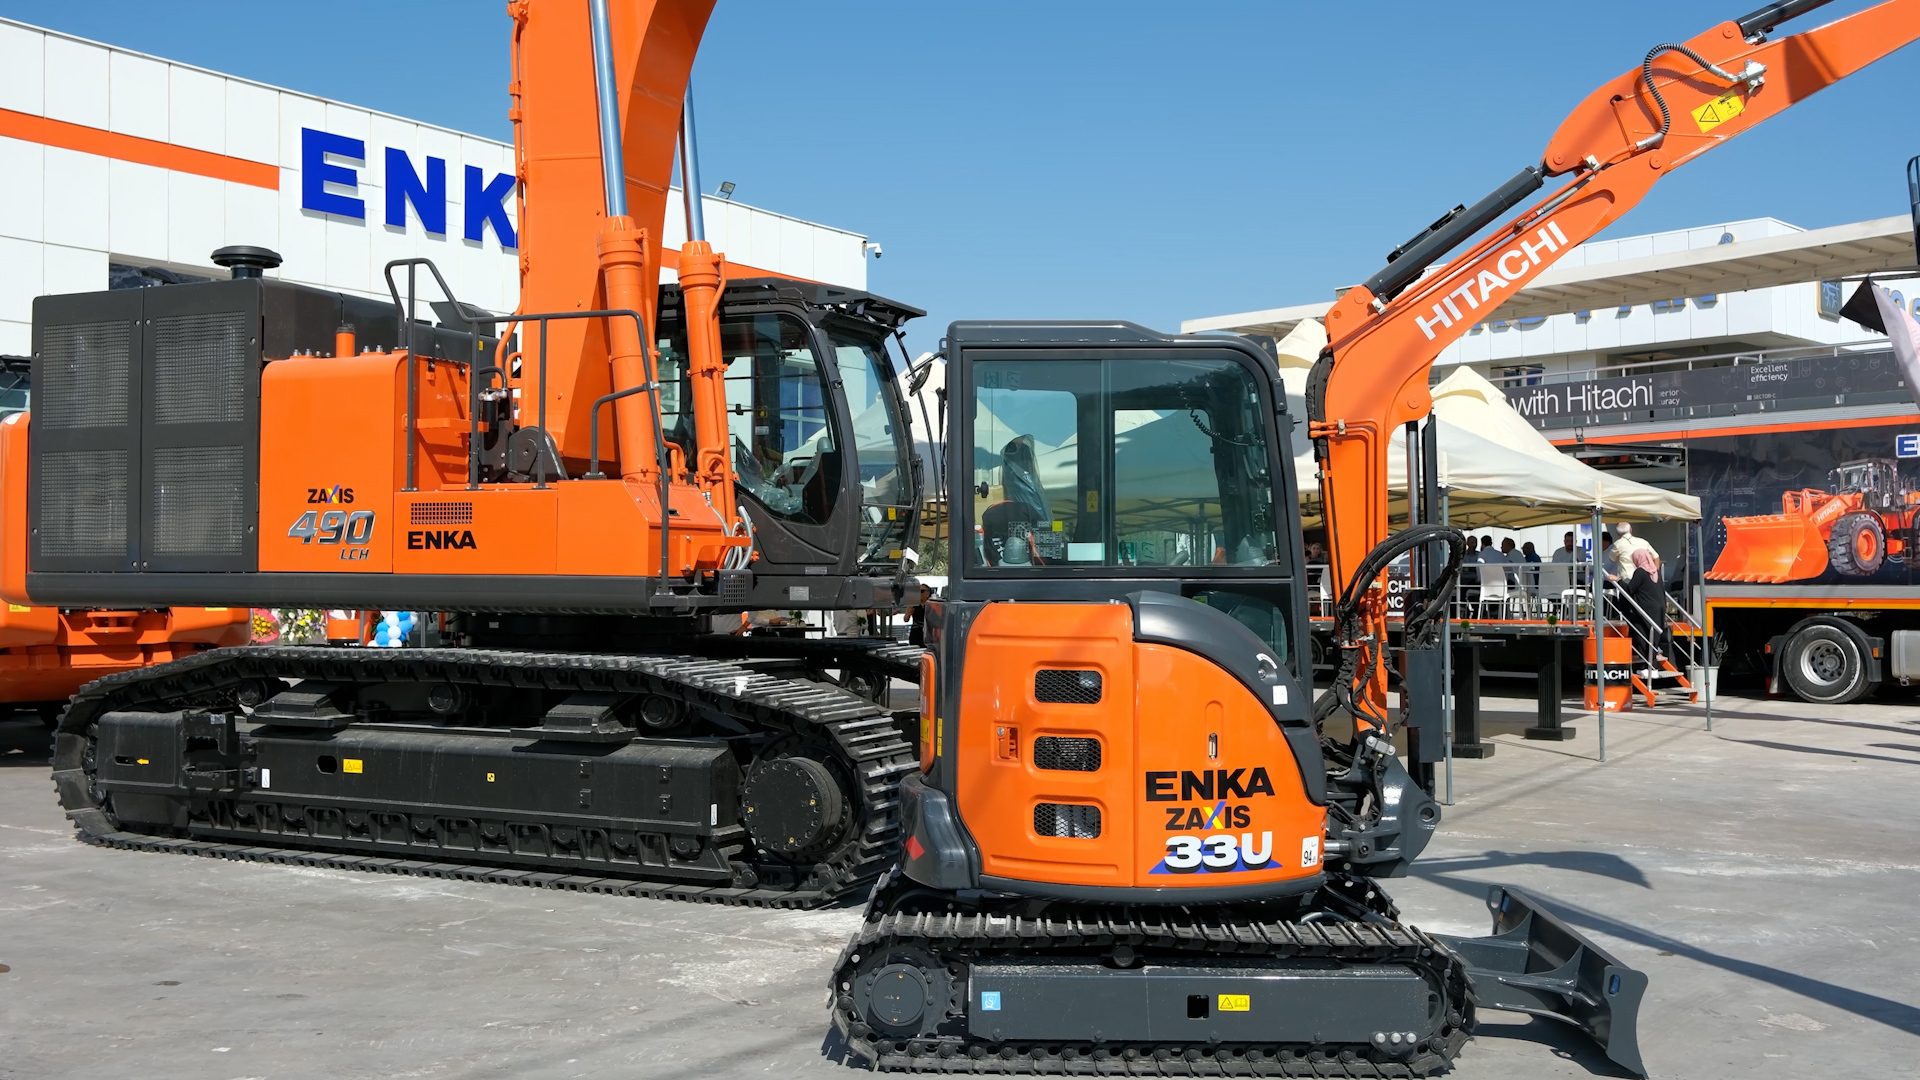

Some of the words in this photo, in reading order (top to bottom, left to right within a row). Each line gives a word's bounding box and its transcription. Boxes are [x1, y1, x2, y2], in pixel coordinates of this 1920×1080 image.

[302, 127, 518, 249] ENK
[1414, 220, 1569, 341] HITACHI
[1750, 364, 1788, 374] Excellent
[1750, 373, 1788, 383] efficiency
[1511, 388, 1559, 416] with
[1566, 377, 1653, 413] Hitachi
[1658, 388, 1680, 398] erior
[1659, 398, 1681, 406] uracy
[307, 484, 355, 505] ZAXIS
[288, 510, 376, 545] 490
[407, 530, 478, 550] ENKA
[339, 548, 370, 560] LCH
[1145, 766, 1276, 802] ENKA
[1165, 801, 1251, 831] ZAXIS
[1164, 831, 1273, 873] 33U
